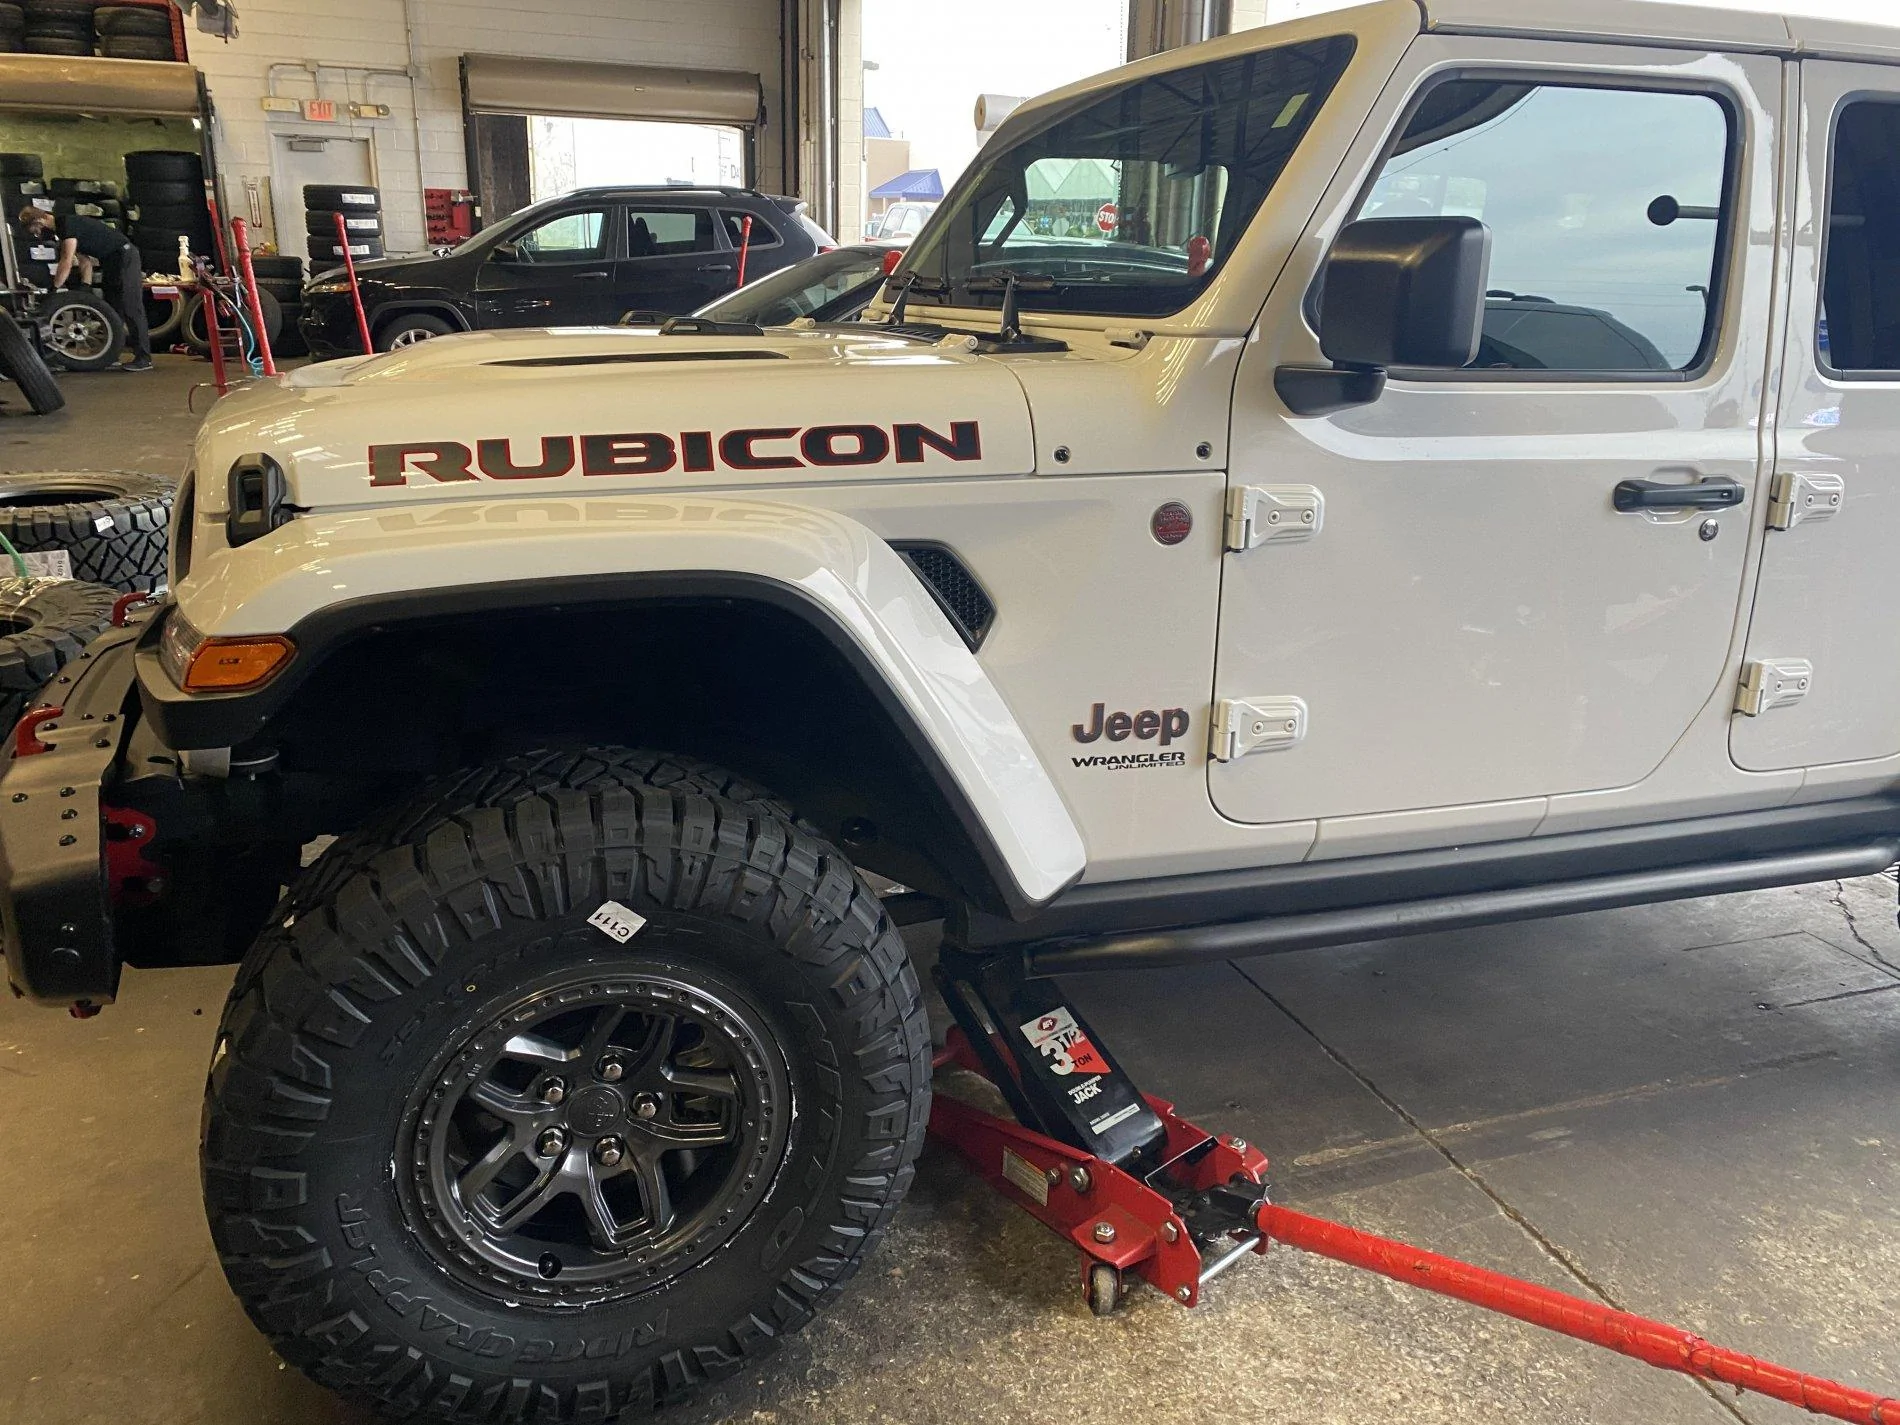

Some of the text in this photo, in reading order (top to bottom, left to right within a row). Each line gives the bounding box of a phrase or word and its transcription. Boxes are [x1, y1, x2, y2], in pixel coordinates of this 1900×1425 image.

[309, 101, 334, 119] EXIT
[368, 421, 982, 487] RUBICON
[1072, 702, 1190, 746] Jeep
[1071, 752, 1185, 768] WRANGLER
[1107, 761, 1185, 770] UNLIMITED
[594, 912, 630, 938] C111
[1072, 1053, 1093, 1069] TON
[1074, 1083, 1103, 1105] JACK
